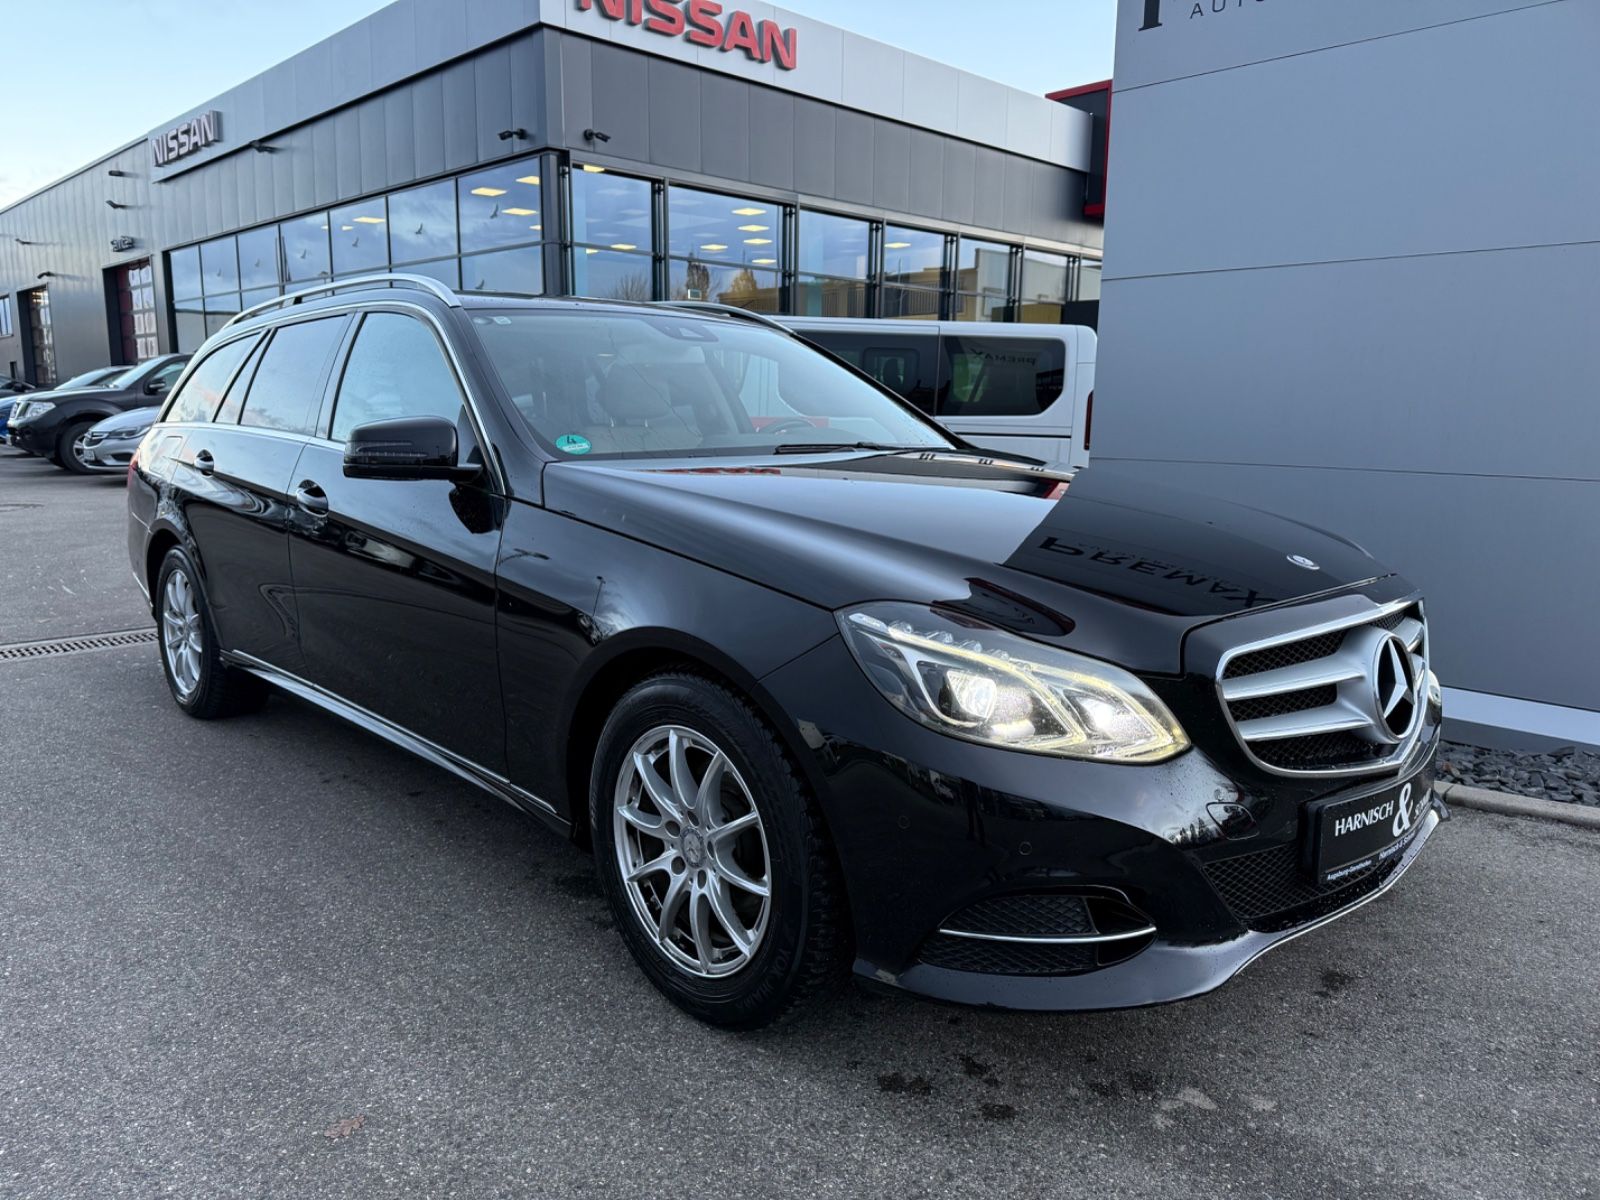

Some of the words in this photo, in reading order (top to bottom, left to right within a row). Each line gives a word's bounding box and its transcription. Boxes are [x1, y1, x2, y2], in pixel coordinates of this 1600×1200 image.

[1190, 0, 1265, 19] AU
[152, 110, 220, 167] NISSAN
[1334, 800, 1394, 837] HARNISCH
[1392, 782, 1413, 838] &
